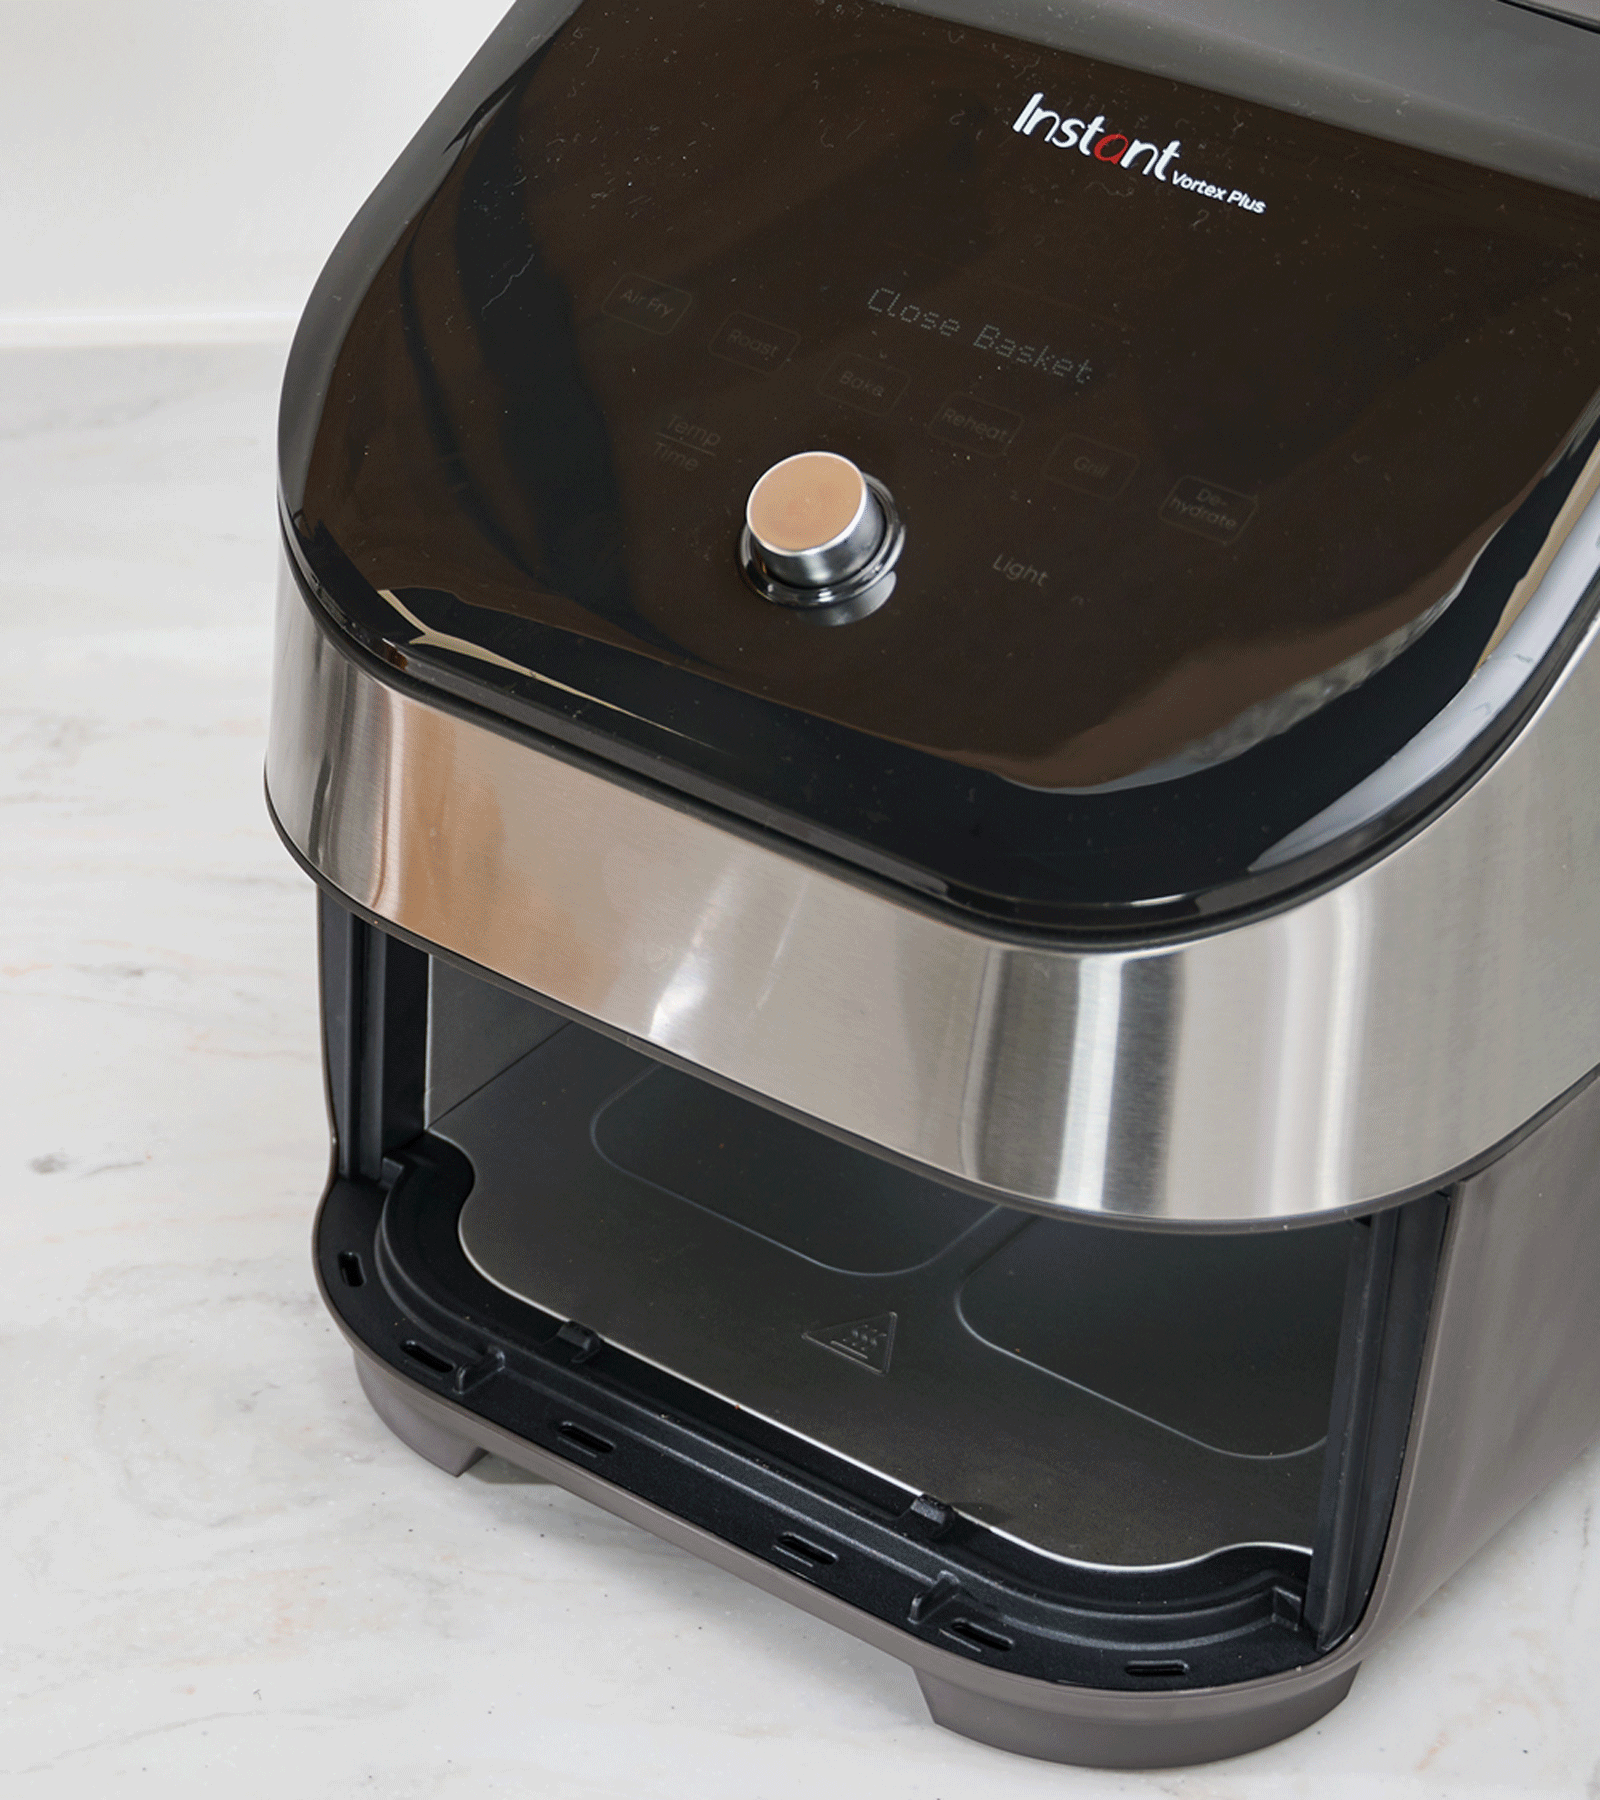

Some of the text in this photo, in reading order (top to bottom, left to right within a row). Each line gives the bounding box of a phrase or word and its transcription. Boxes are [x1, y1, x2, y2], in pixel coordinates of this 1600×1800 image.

[1012, 92, 1180, 181] Instant
[1172, 170, 1267, 214] Vortex Plus
[620, 289, 674, 319] Air Fry
[726, 328, 779, 358] Roast
[868, 287, 1092, 384] Close Basket
[839, 370, 885, 398] Bake
[666, 415, 721, 447] Temp
[941, 407, 1007, 443] Reheat
[653, 441, 699, 472] Time
[1073, 455, 1109, 479] Grill
[1169, 497, 1238, 531] hydrate
[992, 553, 1049, 587] Light
